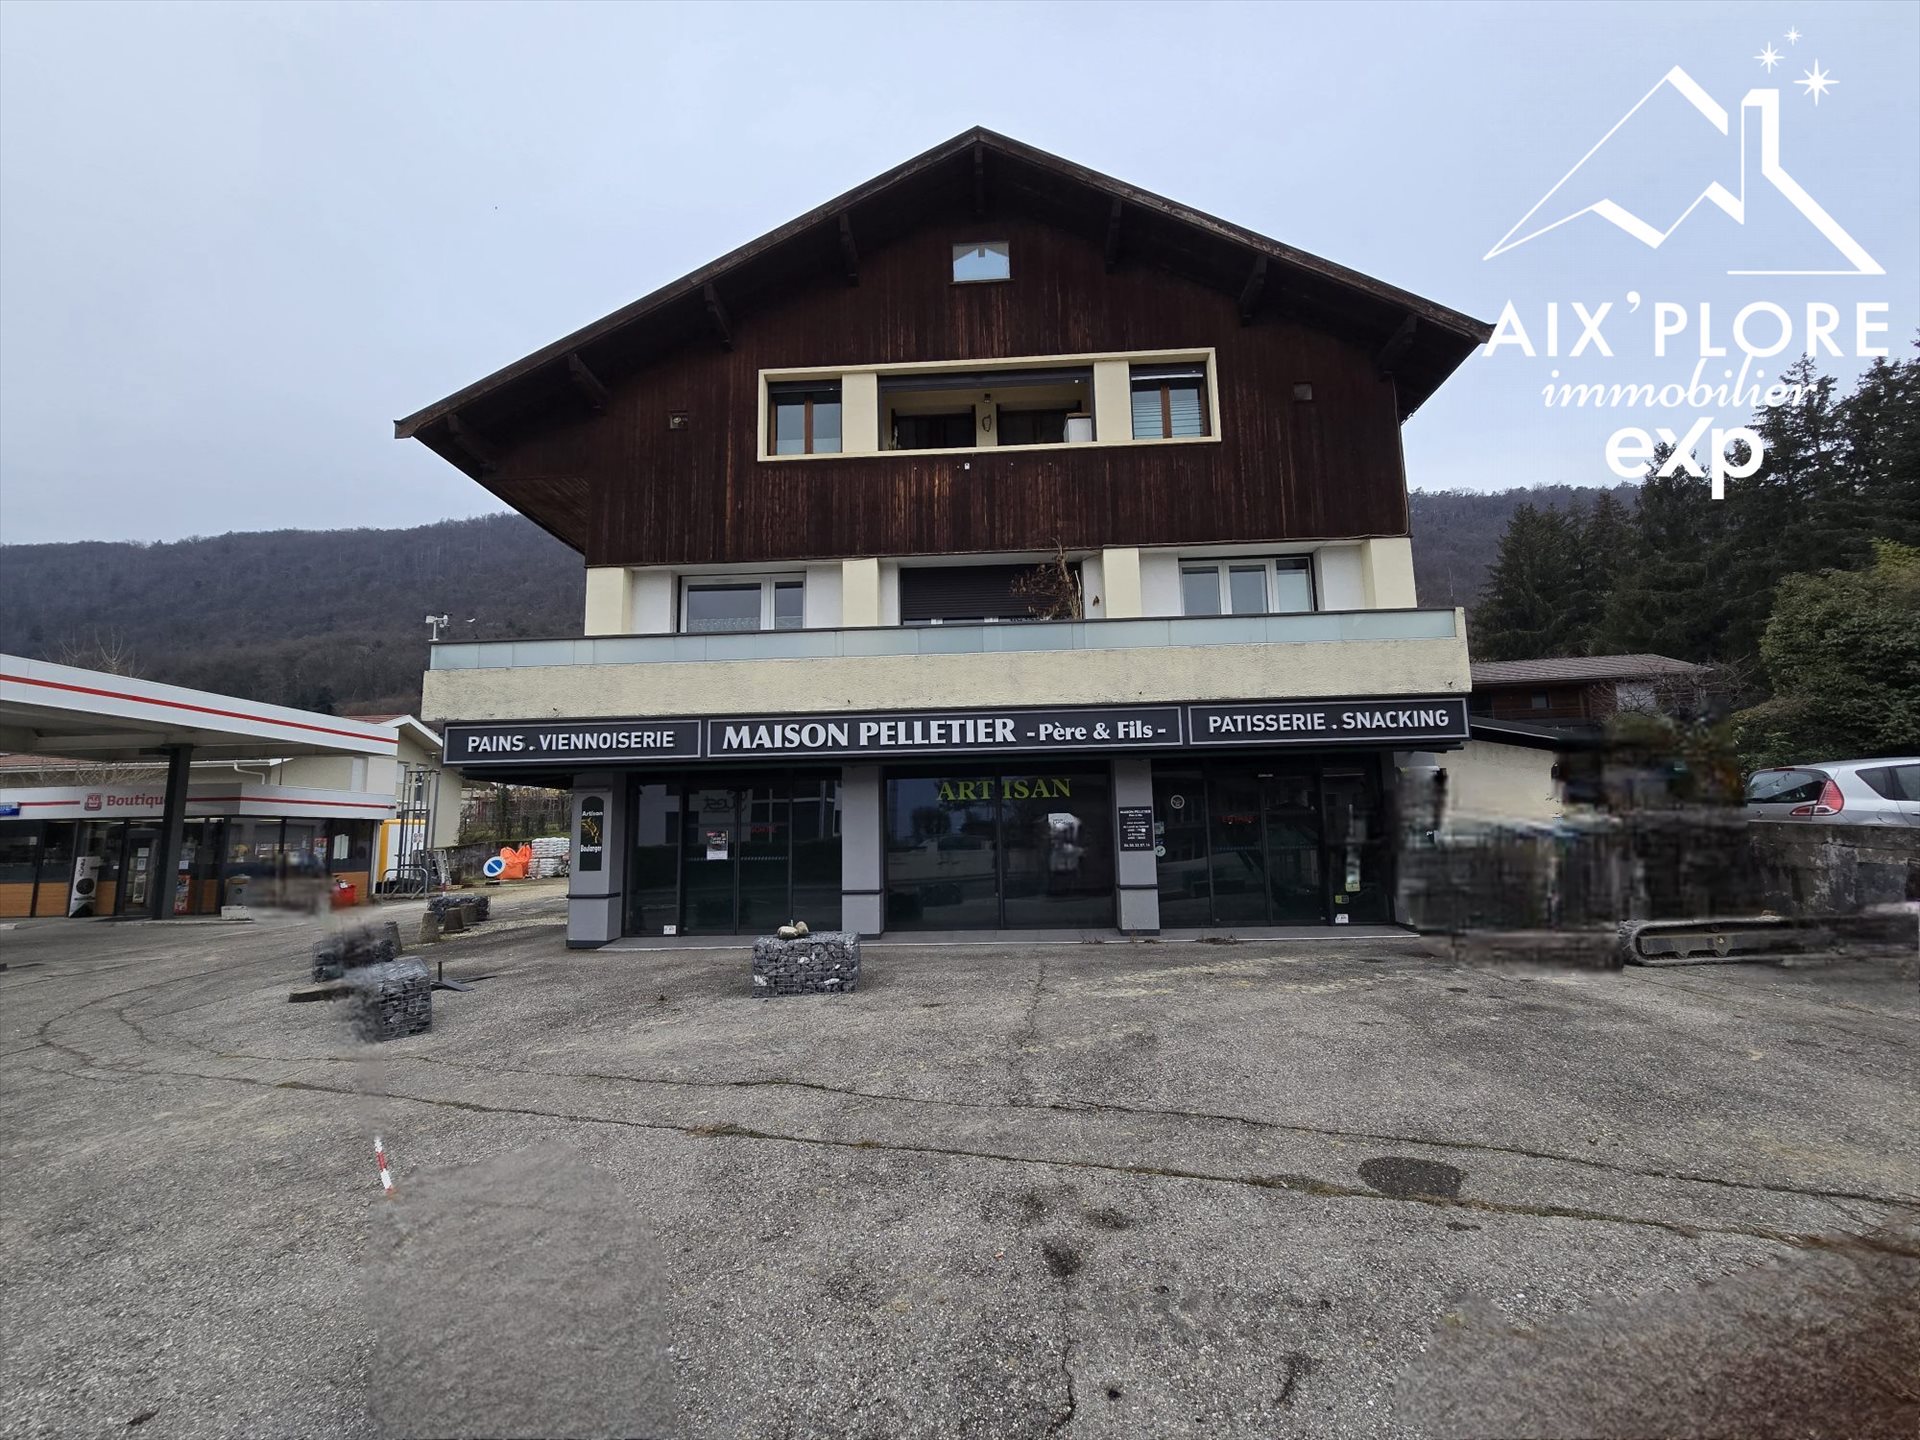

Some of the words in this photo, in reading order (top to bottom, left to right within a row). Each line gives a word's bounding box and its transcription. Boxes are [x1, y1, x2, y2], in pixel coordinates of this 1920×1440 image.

[1208, 712, 1327, 733] PATISSERIE
[1342, 709, 1449, 730] SNACKING
[467, 734, 527, 753] PAINS
[538, 730, 676, 751] VIENNOISERIE
[722, 722, 849, 750] MAISON
[859, 718, 1017, 746] PELLETIER
[1092, 722, 1111, 740] &
[106, 793, 164, 808] Boutiqu
